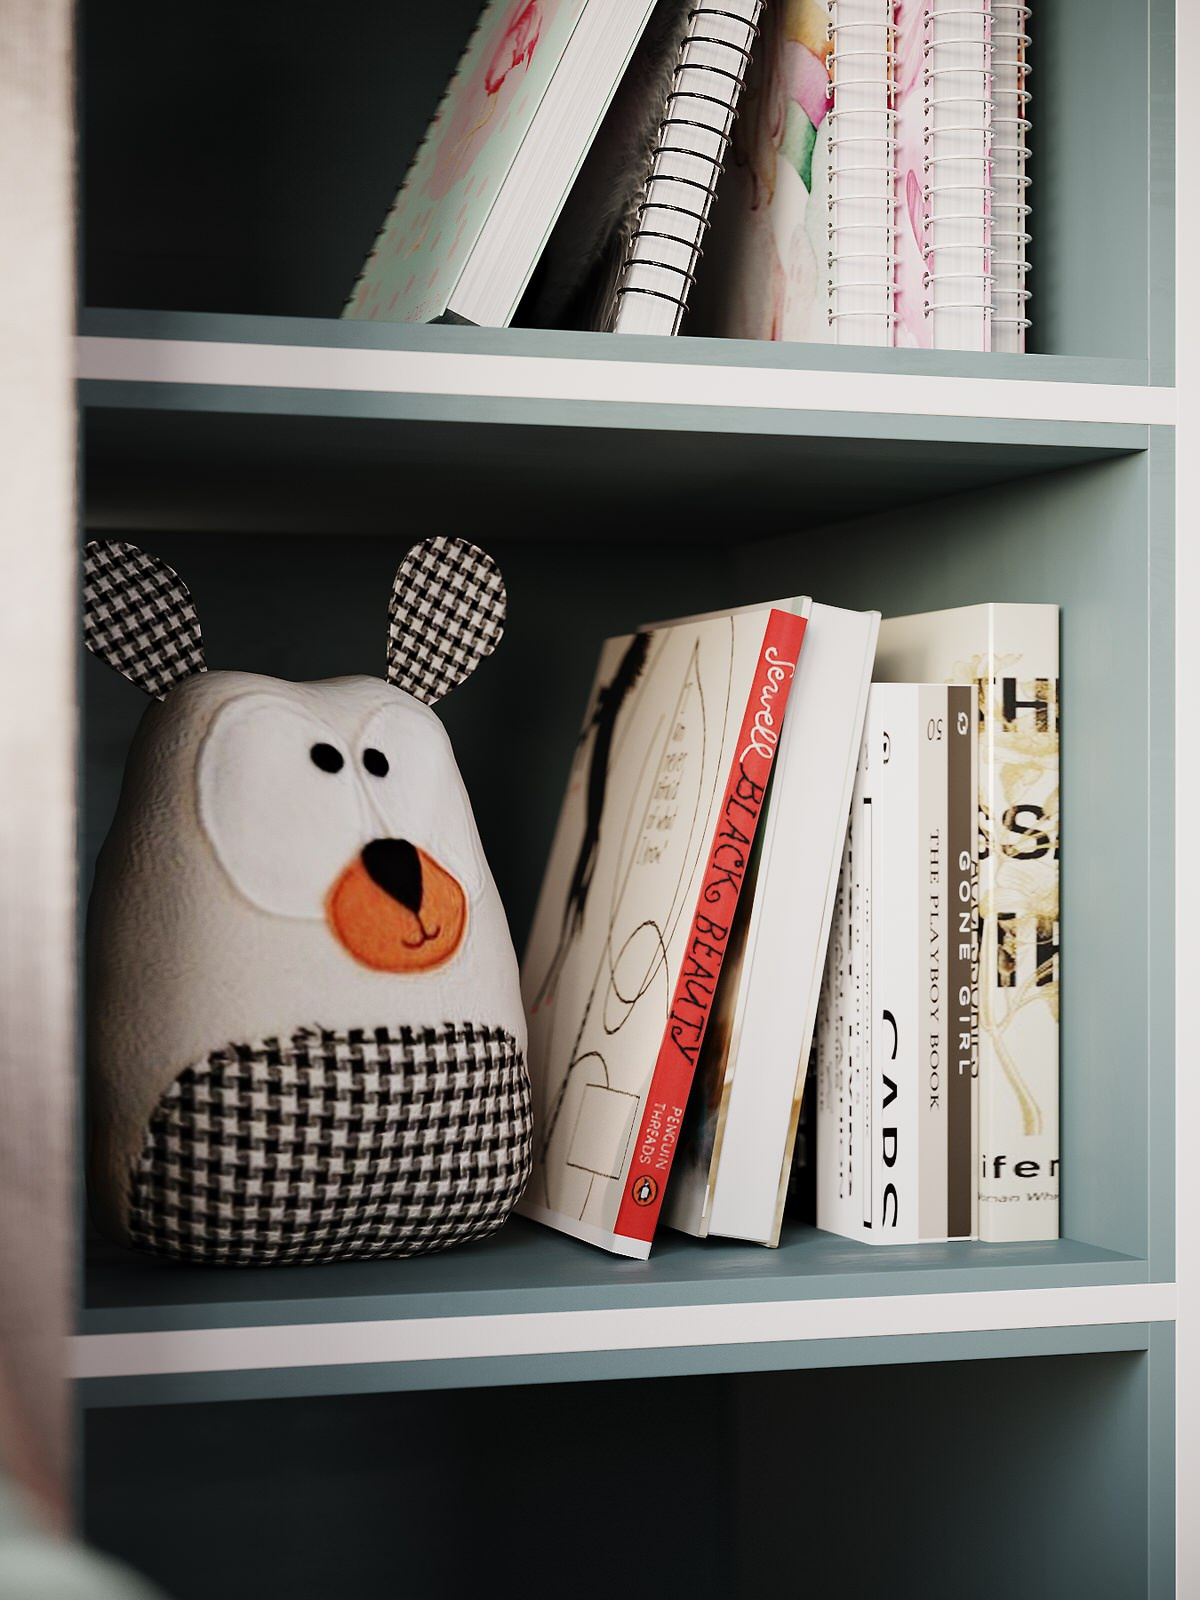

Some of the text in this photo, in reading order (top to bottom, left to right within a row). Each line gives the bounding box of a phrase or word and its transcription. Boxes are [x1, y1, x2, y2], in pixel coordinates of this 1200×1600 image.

[669, 646, 796, 1066] Sewell BLACK BEAUTY
[958, 851, 971, 1076] GONE GIRL
[930, 829, 940, 1112] THE PLAYBOY BOOK
[639, 1102, 667, 1165] THREADS
[656, 1106, 683, 1170] PENGUIN
